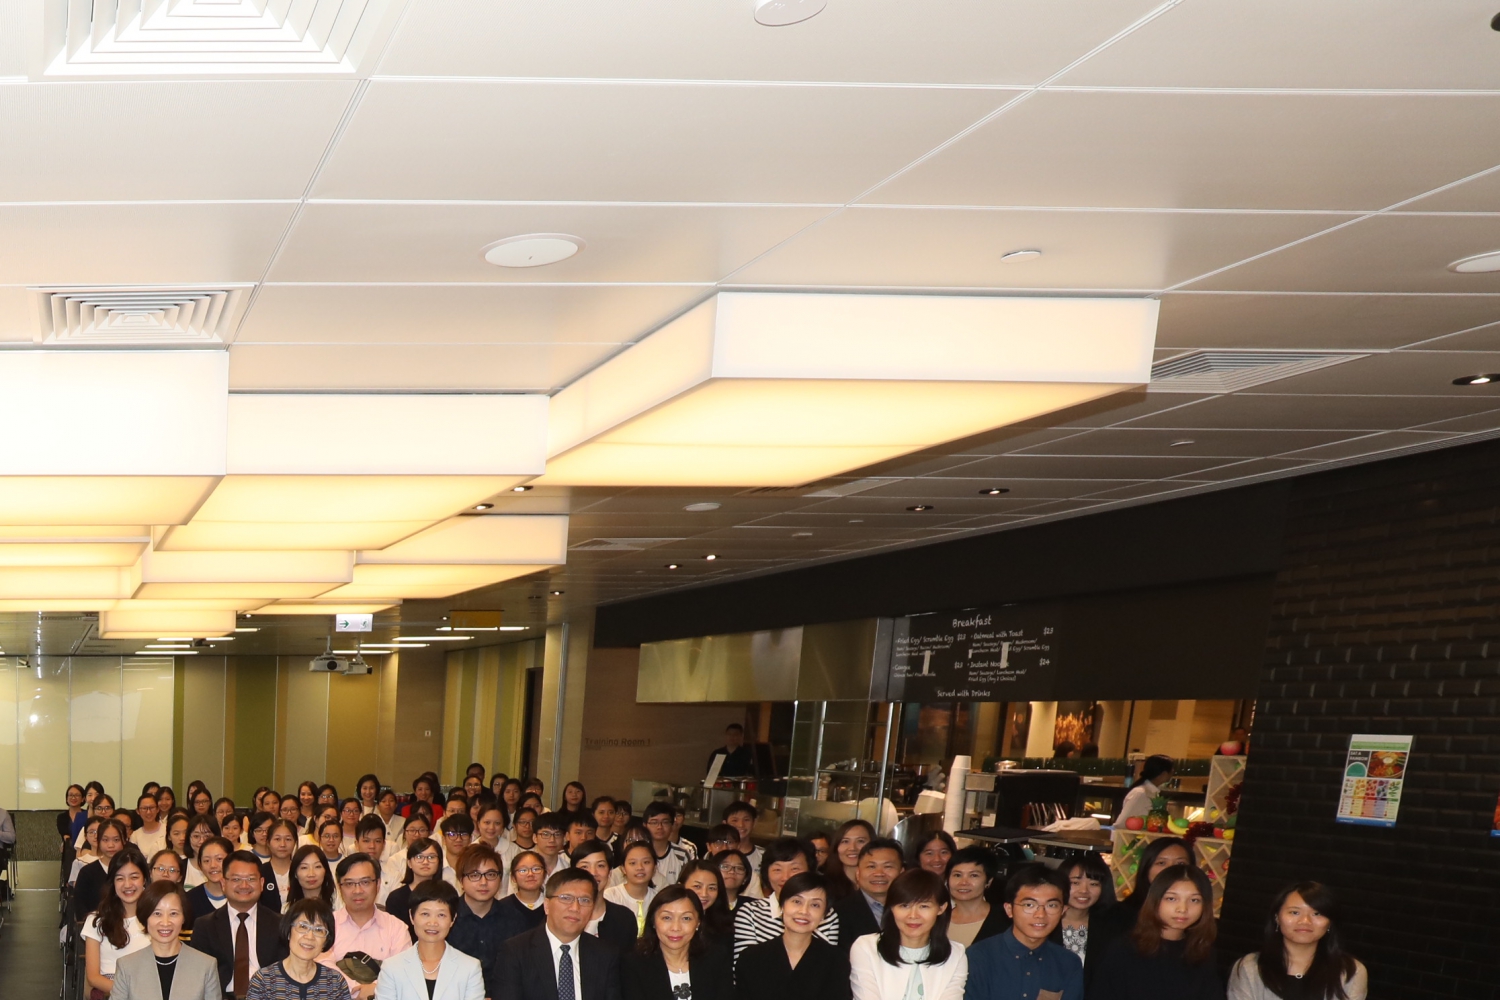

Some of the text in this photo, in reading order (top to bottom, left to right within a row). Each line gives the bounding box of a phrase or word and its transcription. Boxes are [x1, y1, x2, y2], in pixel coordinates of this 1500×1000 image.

[953, 614, 992, 628] Breakfast
[944, 635, 954, 643] Egg
[937, 689, 955, 697] Served
[585, 738, 618, 746] Training
[621, 738, 645, 746] Room
